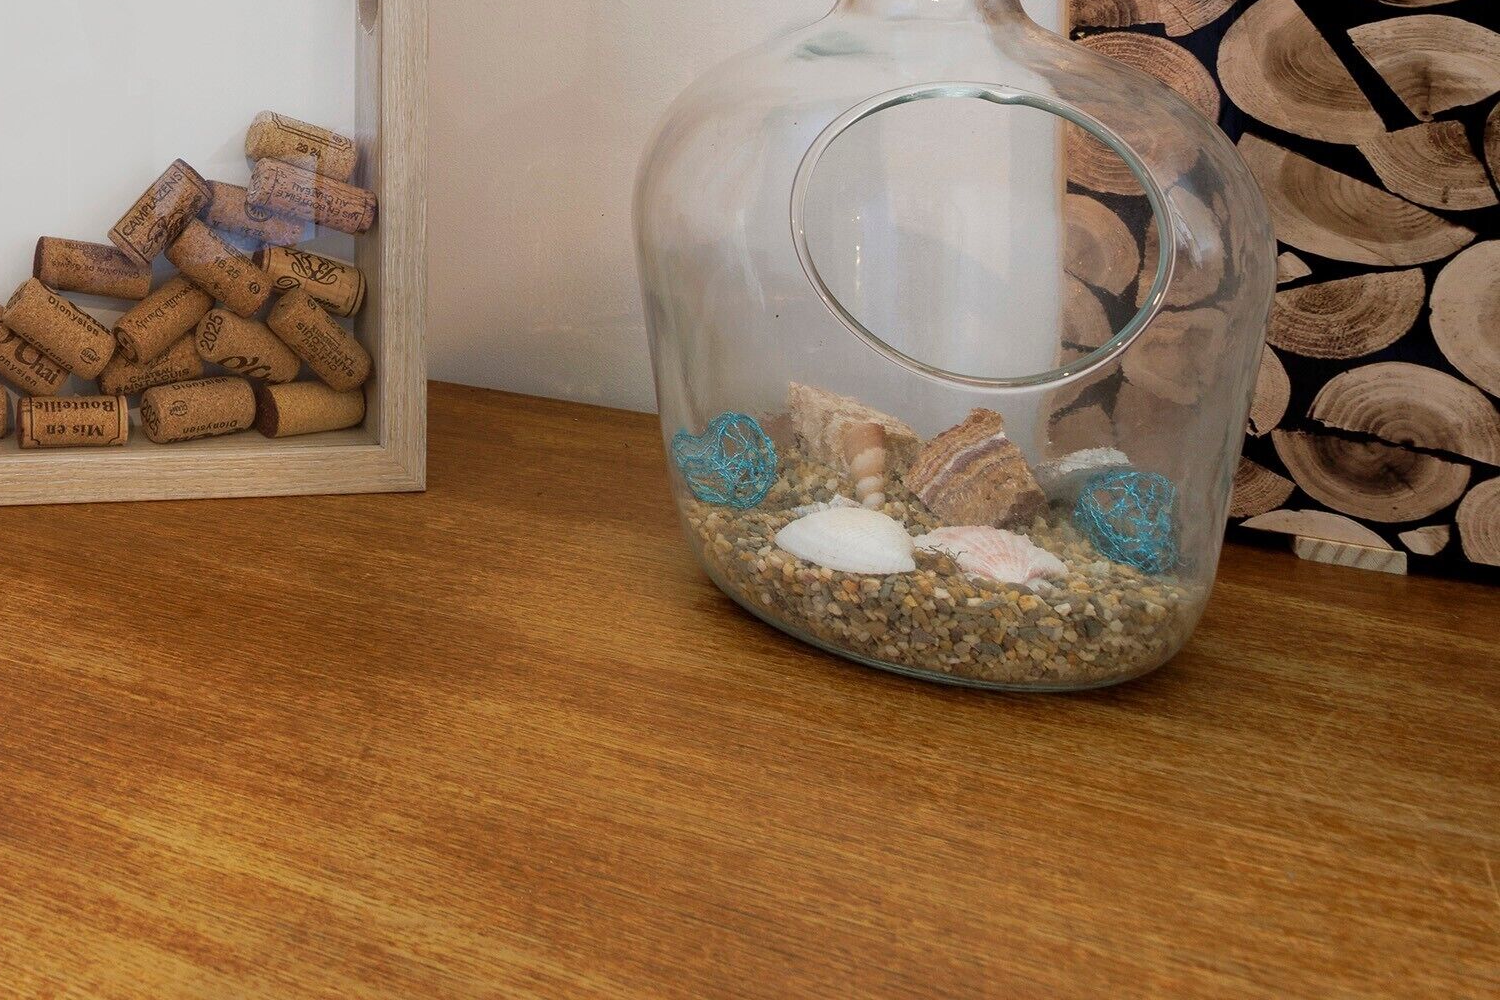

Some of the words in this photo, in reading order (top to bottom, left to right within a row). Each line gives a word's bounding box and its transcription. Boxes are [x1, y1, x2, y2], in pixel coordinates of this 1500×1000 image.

[121, 171, 183, 238] CAMPLAZENS
[226, 266, 241, 279] 25
[48, 296, 100, 337] Dionysien
[200, 314, 224, 352] 2025
[171, 377, 229, 391] Dionysien
[34, 401, 115, 413] Bouteille
[45, 424, 66, 435] en
[72, 423, 106, 437] Mis
[182, 419, 238, 434] Dionysien
